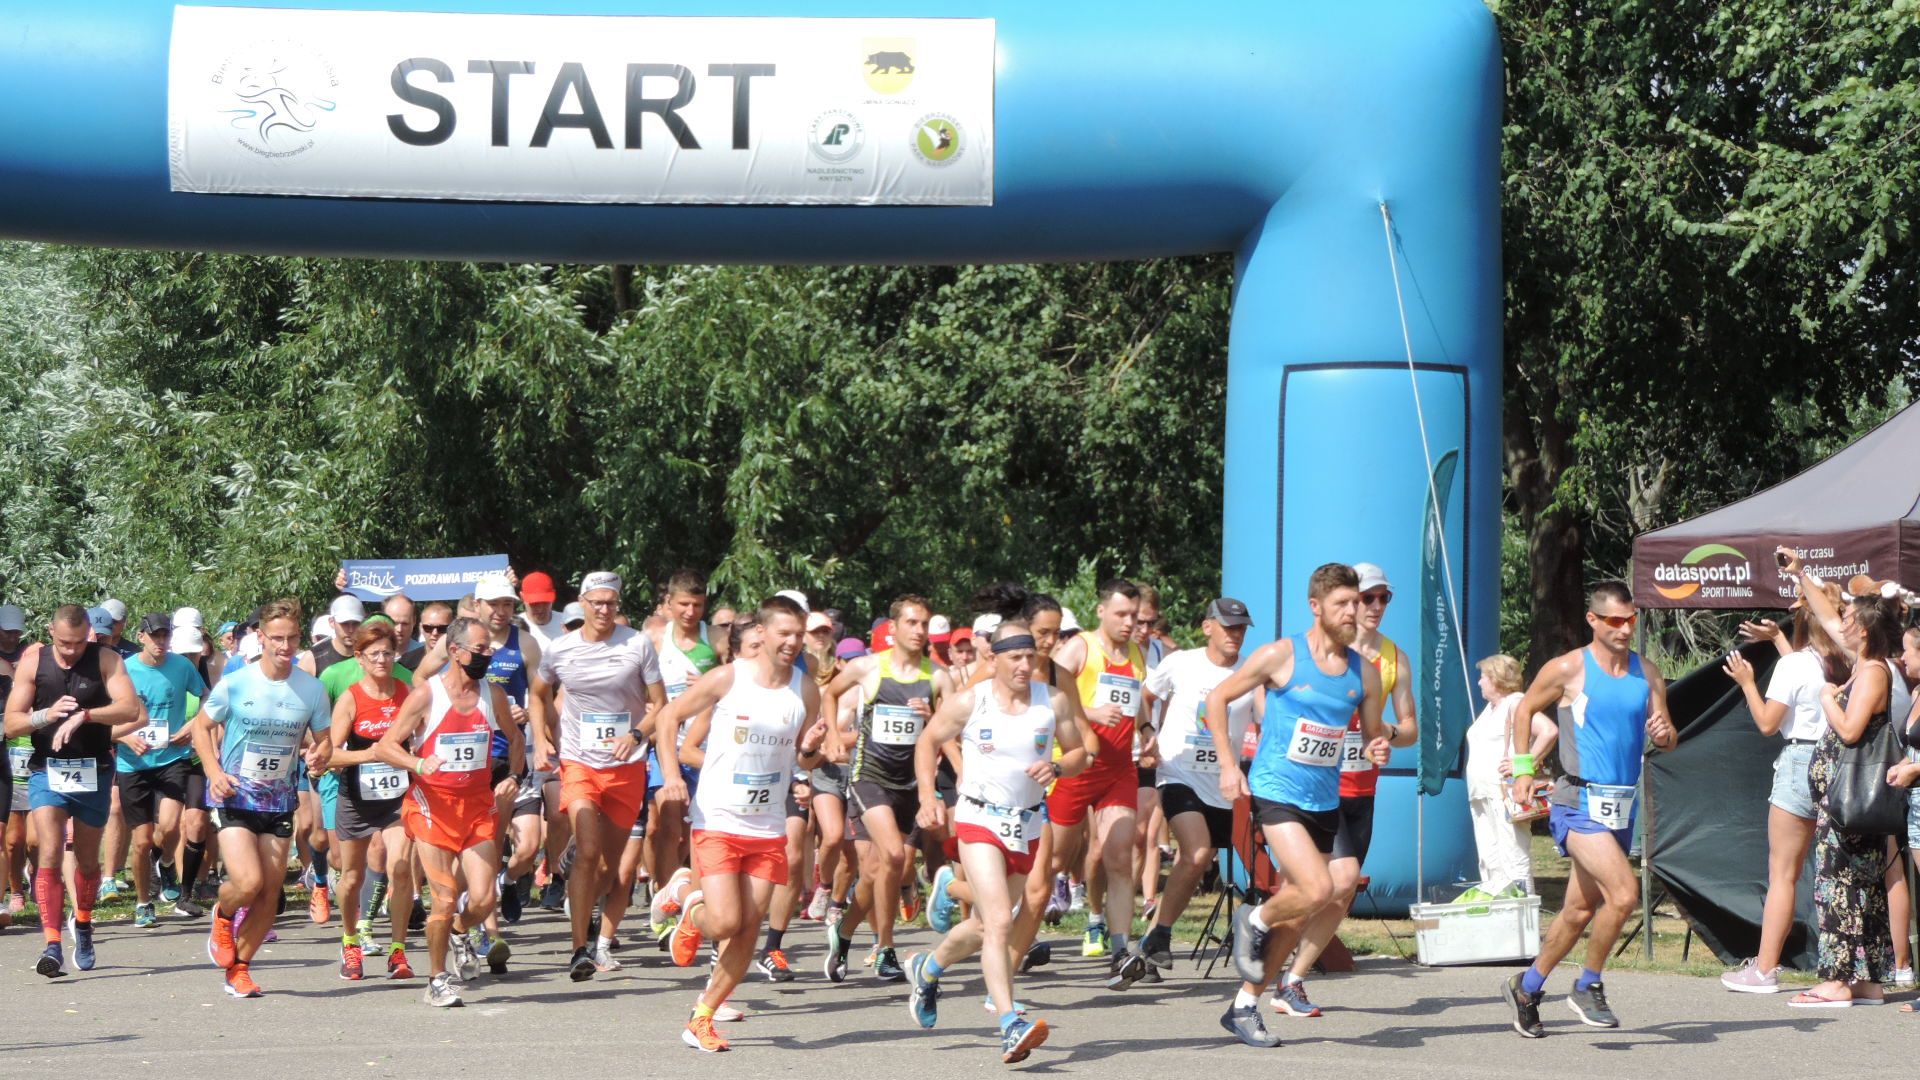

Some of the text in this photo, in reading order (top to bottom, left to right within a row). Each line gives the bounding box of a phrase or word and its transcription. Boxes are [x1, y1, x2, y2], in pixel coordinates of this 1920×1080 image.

[386, 57, 776, 150] START
[1809, 547, 1834, 558] czasu
[350, 569, 400, 588] Bałtyk
[405, 572, 460, 585] POZDRAWIA
[1654, 561, 1751, 584] datasport.pl
[1701, 587, 1753, 598] SPORT TIMING
[1110, 689, 1131, 705] 69
[597, 727, 616, 740] 18
[883, 720, 915, 735] 158
[454, 746, 475, 761] 19
[1298, 737, 1338, 758] 3785
[1195, 749, 1218, 763] 25
[257, 757, 281, 771] 45
[61, 770, 82, 783] 74
[370, 775, 399, 790] 140
[747, 788, 770, 804] 72
[1600, 801, 1621, 818] 54
[1000, 822, 1022, 838] 32
